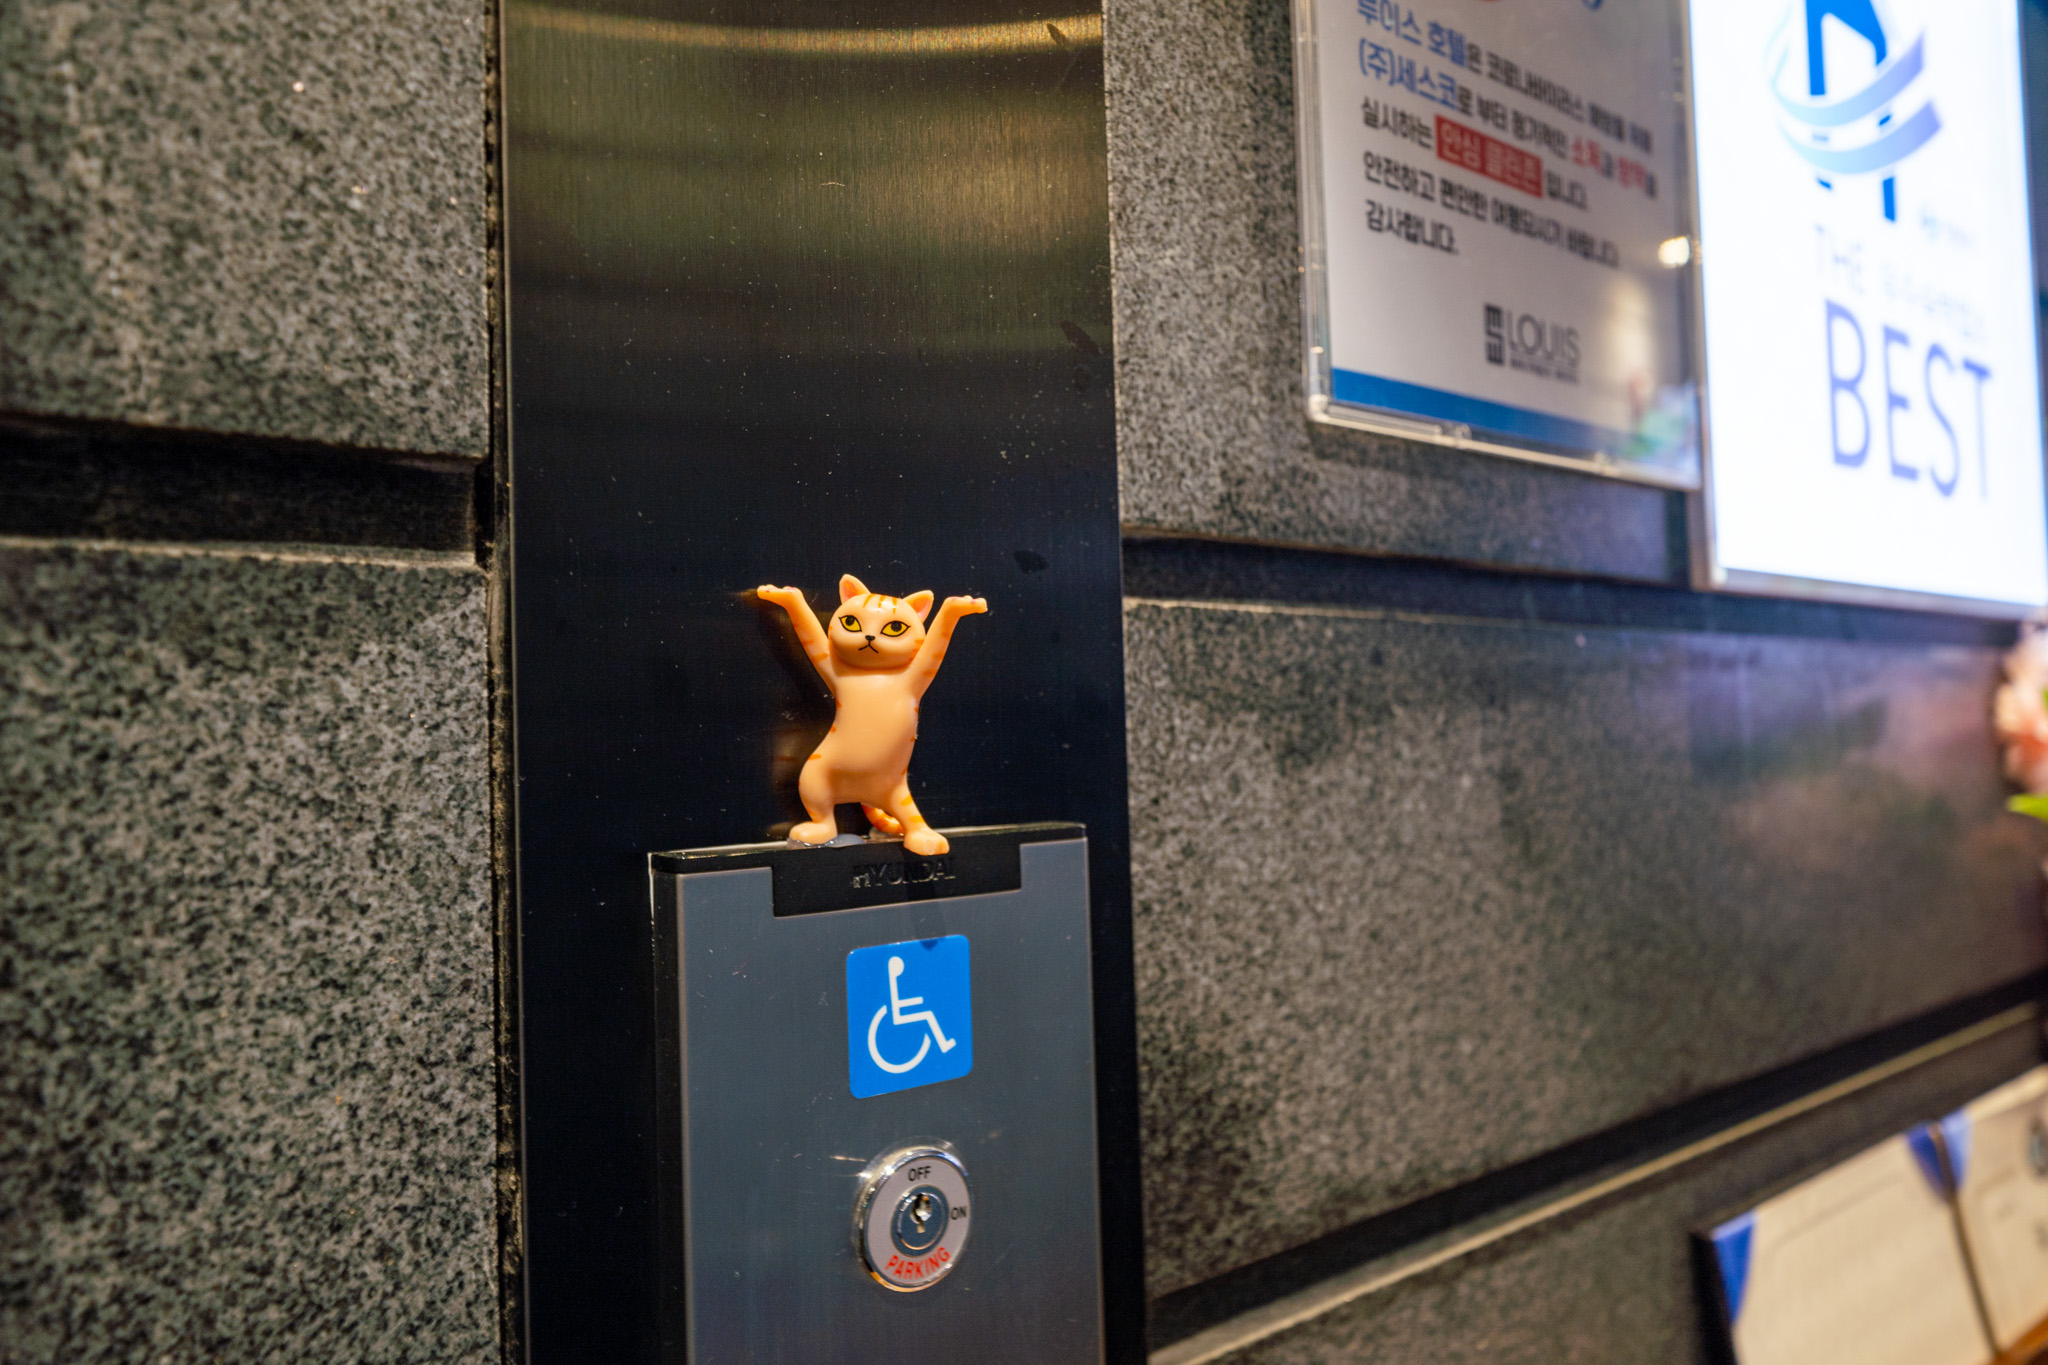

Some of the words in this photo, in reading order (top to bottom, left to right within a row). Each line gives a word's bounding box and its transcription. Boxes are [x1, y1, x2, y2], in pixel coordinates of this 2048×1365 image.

[1361, 96, 1433, 149] 실시하는
[1507, 310, 1582, 369] LOUIS
[1824, 298, 1993, 501] BEST
[908, 1166, 932, 1181] OFF
[950, 1205, 967, 1220] ON
[885, 1246, 950, 1280] PARKING
